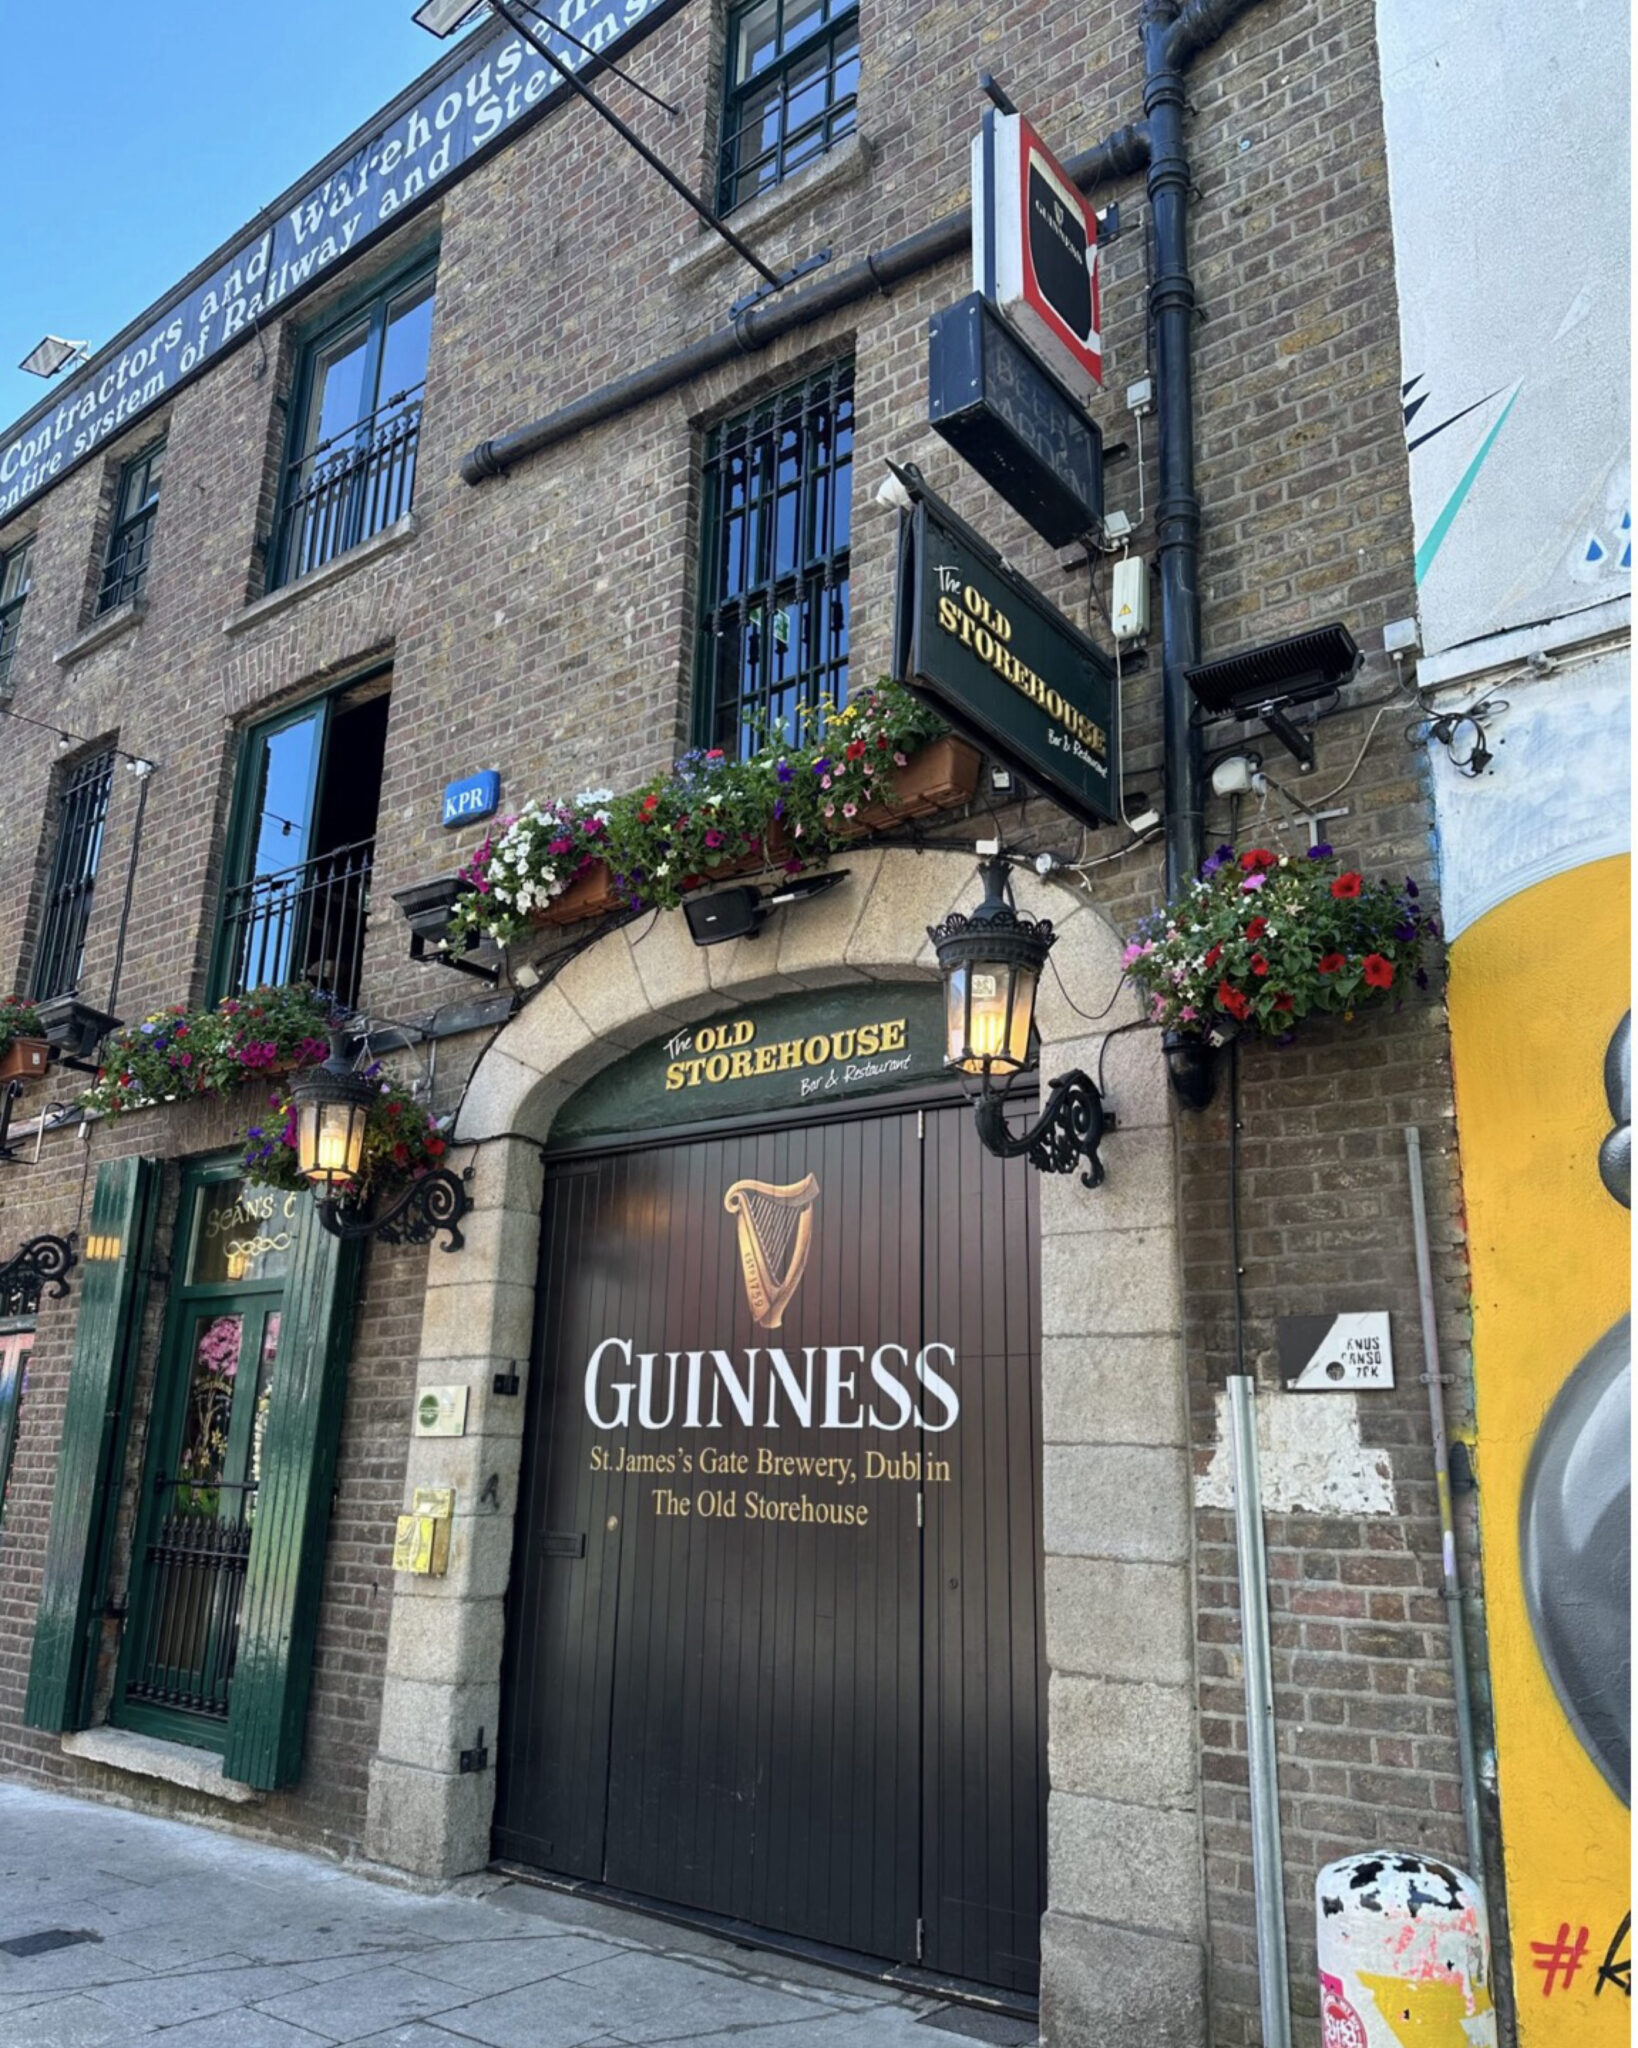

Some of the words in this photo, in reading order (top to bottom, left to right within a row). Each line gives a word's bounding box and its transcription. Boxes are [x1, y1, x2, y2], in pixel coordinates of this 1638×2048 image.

[0, 451, 62, 514] entire
[73, 371, 166, 458] system
[180, 326, 209, 373] of
[221, 212, 362, 342] Railway
[379, 132, 450, 219] and
[472, 0, 667, 147] Steams
[1, 317, 183, 483] Contractors
[199, 231, 272, 323] and
[933, 564, 961, 594] The
[964, 585, 1011, 642] OLD
[939, 597, 1106, 758] STOREHOUSE
[446, 787, 483, 818] KPR
[663, 1028, 692, 1060] The
[695, 1020, 755, 1053] OLD
[665, 1018, 907, 1091] STOREHOUSE
[801, 1076, 822, 1097] Bar
[824, 1069, 838, 1089] &
[844, 1054, 912, 1084] Restaurant
[748, 1277, 763, 1307] 1759
[584, 1337, 960, 1432] GUINNESS
[700, 1447, 749, 1474] Gate
[757, 1448, 857, 1485] Brewery,
[865, 1450, 951, 1481] Dublin
[652, 1489, 690, 1516] The
[698, 1490, 737, 1517] Old
[745, 1491, 869, 1526] Storehouse
